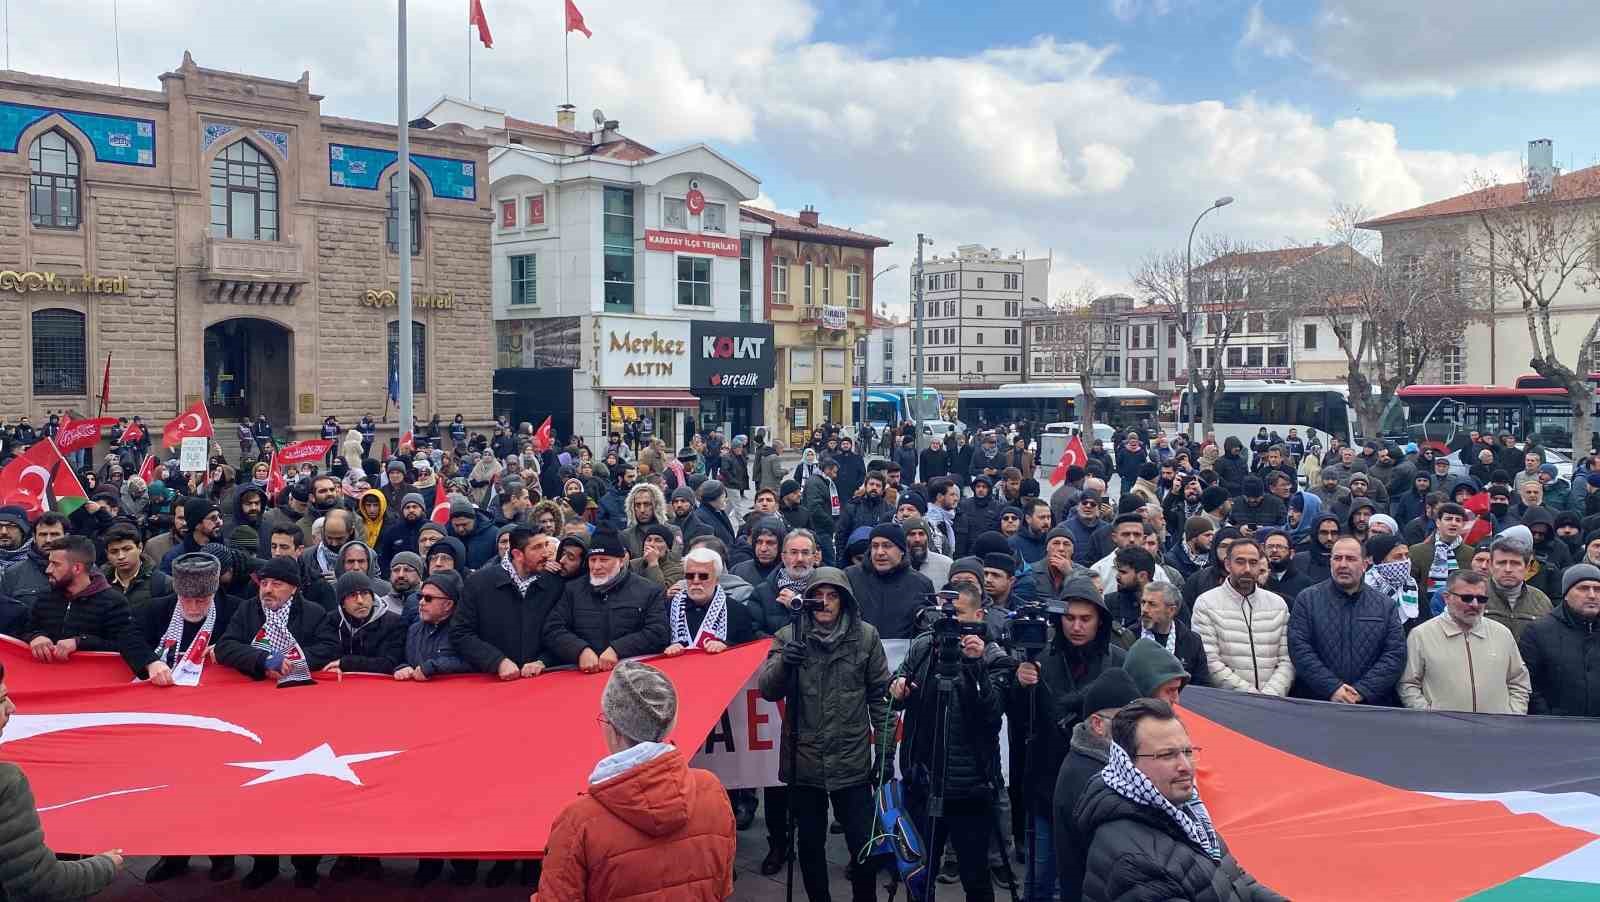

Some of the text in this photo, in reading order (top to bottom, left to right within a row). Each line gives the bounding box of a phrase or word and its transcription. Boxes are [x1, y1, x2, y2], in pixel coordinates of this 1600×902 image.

[648, 235, 738, 252] KARATAY İLÇE TEŞKİLATI
[609, 328, 685, 355] Merkez
[702, 336, 766, 359] KOLAT
[624, 361, 673, 377] ALTIN
[721, 372, 759, 388] arçelik
[705, 707, 735, 754] A
